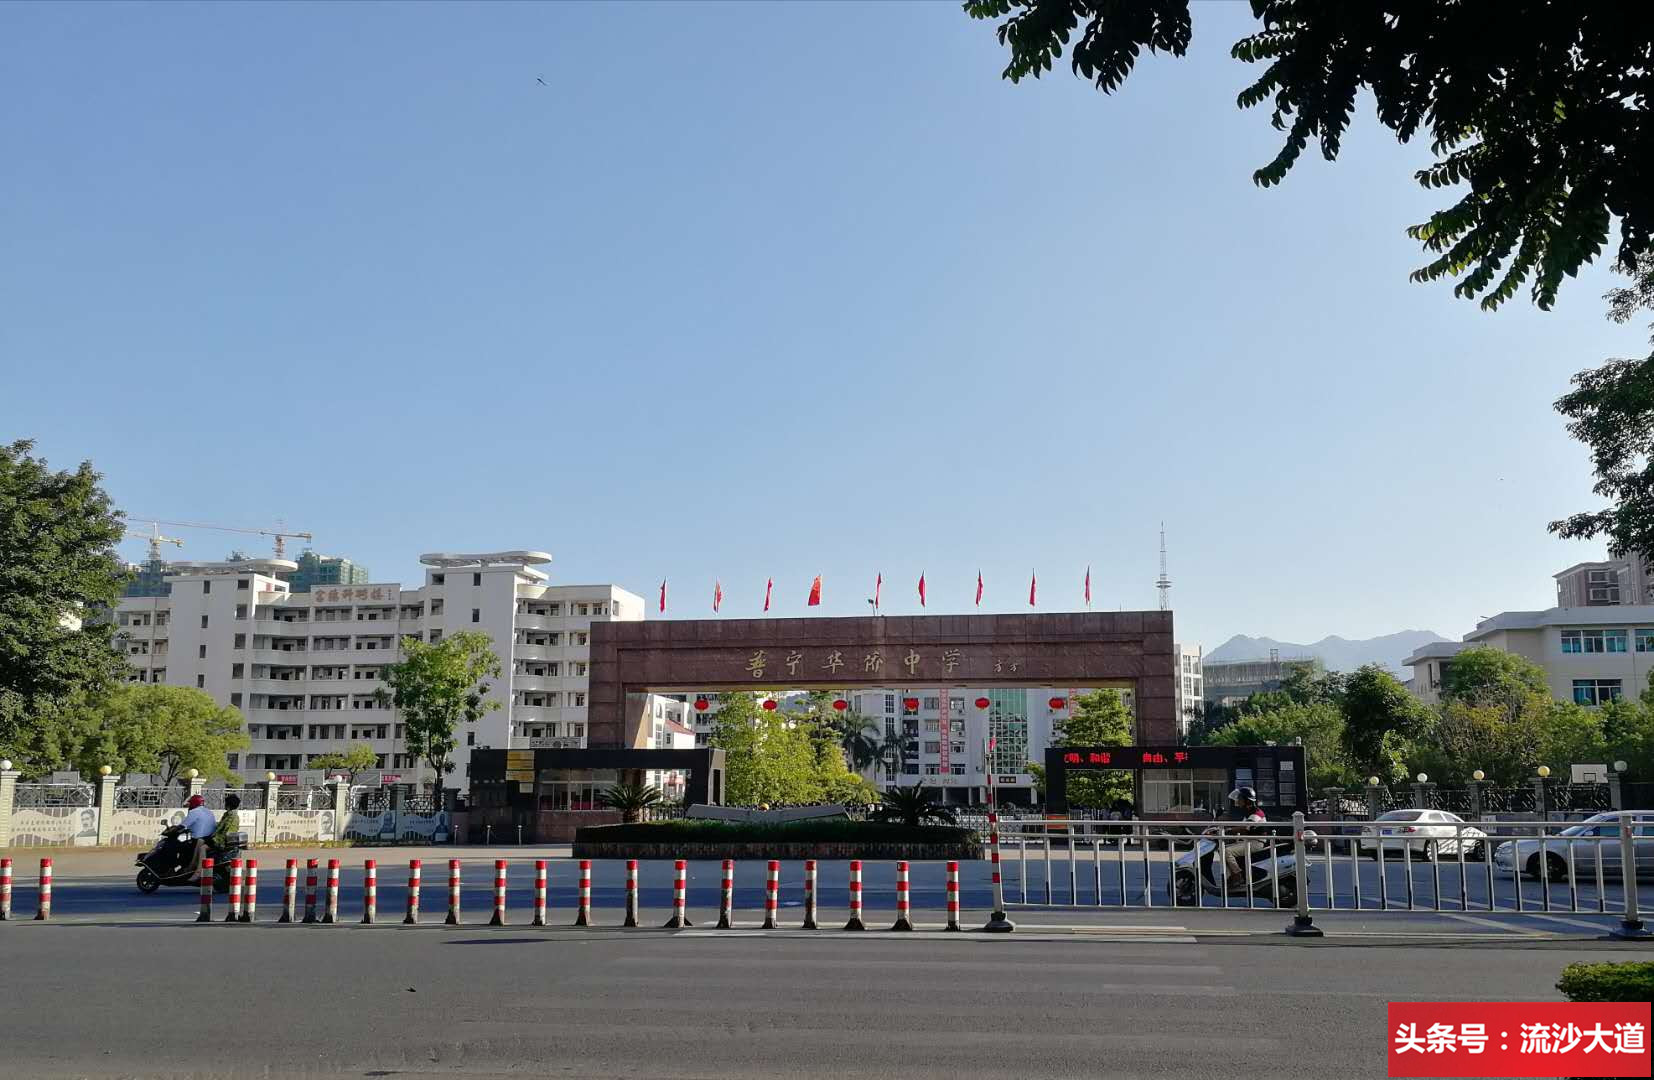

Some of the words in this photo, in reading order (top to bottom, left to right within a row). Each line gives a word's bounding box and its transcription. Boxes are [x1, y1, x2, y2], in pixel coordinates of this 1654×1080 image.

[745, 649, 960, 678] 普宁华侨中学
